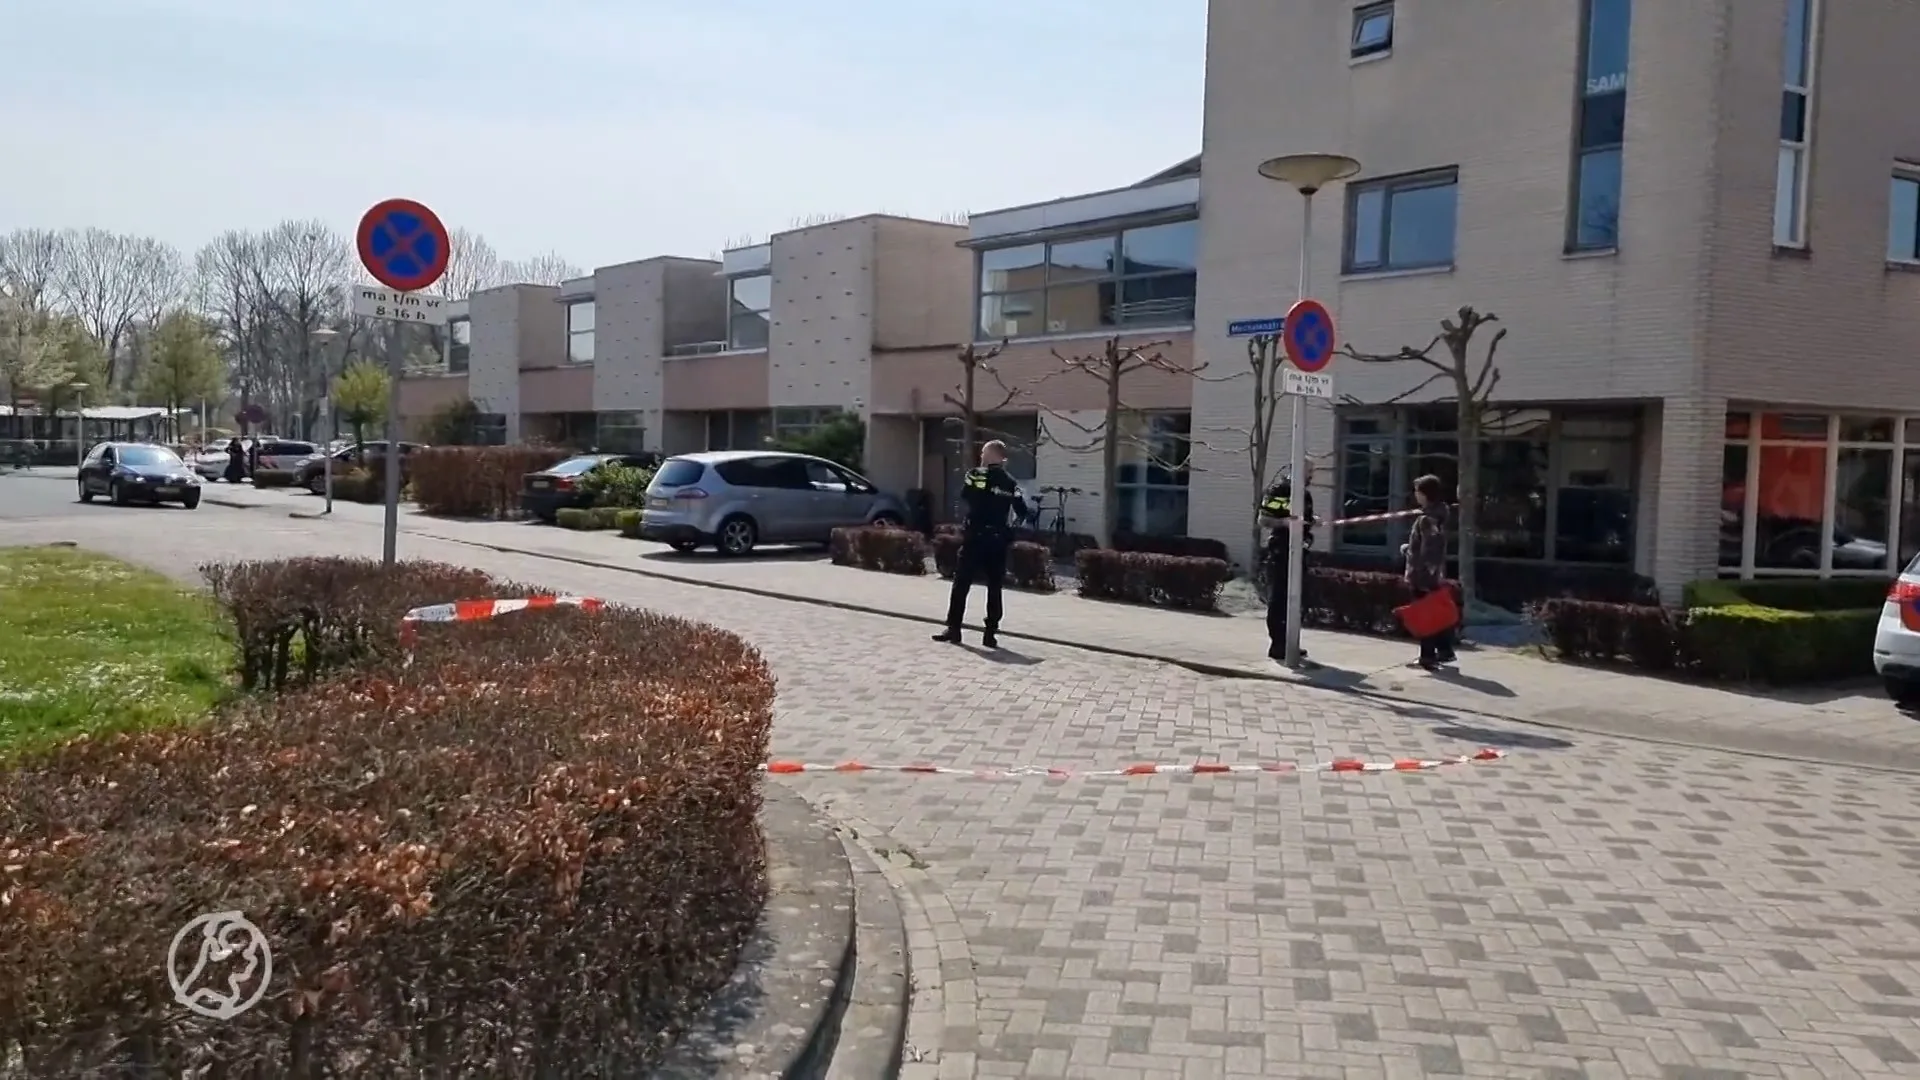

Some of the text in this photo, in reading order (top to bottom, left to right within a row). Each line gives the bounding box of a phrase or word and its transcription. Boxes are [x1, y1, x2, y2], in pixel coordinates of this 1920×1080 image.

[362, 291, 440, 308] ma t/m vr
[376, 306, 426, 320] 8-16 h
